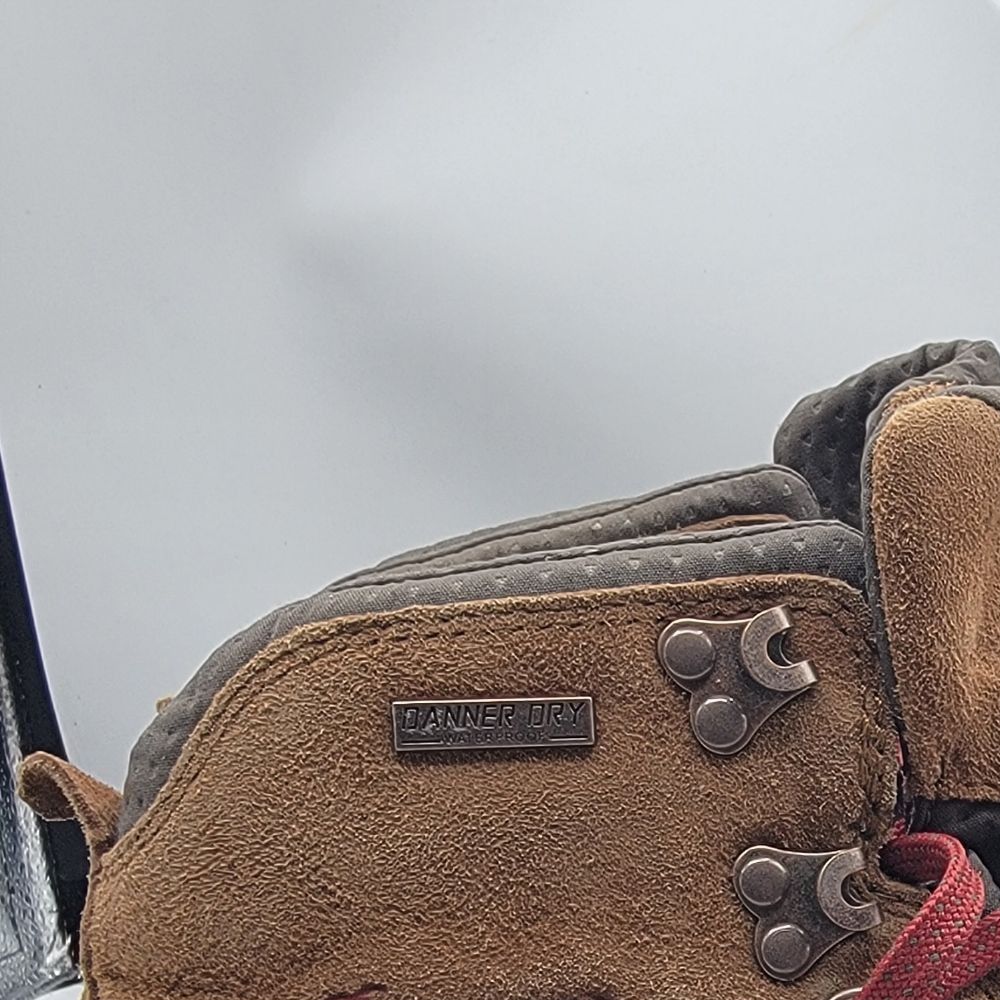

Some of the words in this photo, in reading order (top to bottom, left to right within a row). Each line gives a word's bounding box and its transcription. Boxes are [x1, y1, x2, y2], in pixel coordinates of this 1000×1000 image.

[401, 704, 516, 731] DANNER
[528, 702, 587, 728] DRY
[441, 731, 549, 745] WATERPROOF
